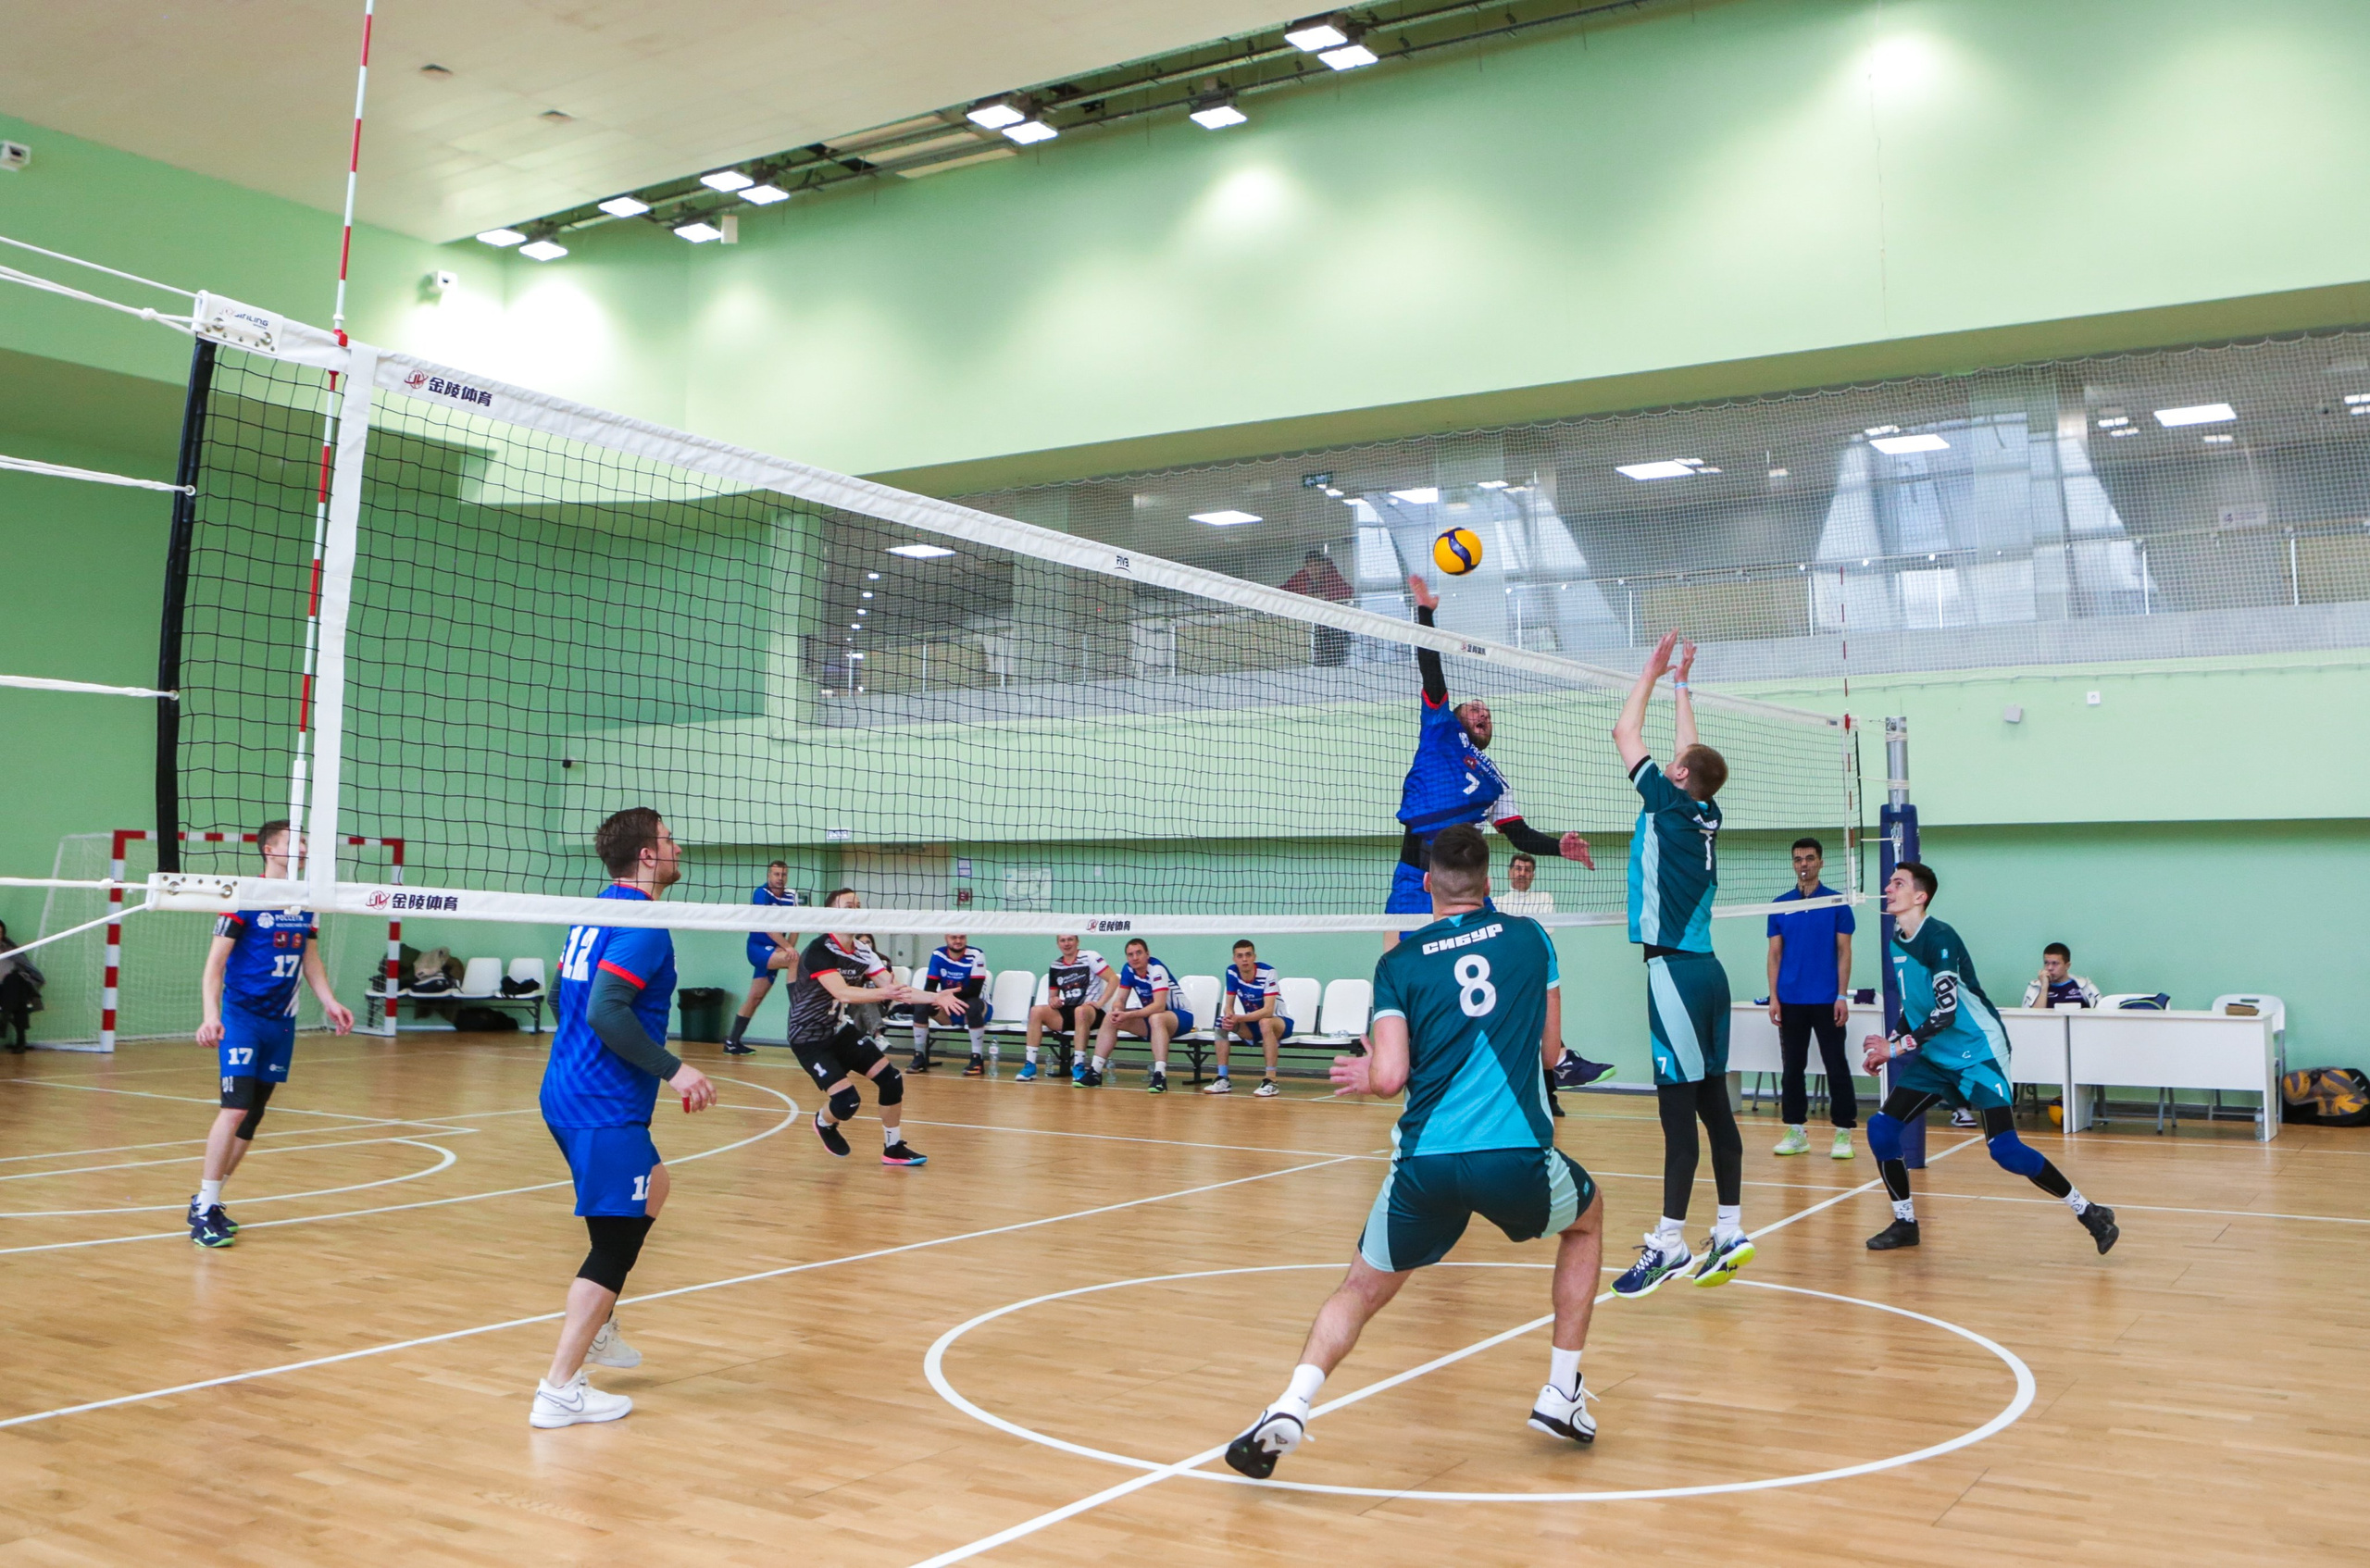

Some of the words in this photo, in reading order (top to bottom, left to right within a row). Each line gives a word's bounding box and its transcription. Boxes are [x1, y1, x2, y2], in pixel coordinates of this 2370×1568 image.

[429, 376, 493, 407] 金陵体育
[1463, 772, 1480, 794] 7
[393, 892, 458, 911] 金陵体育
[1422, 923, 1503, 955] СИБУР
[561, 926, 600, 981] 12
[271, 954, 300, 977] 17
[1453, 953, 1497, 1017] 8
[1898, 968, 1907, 1000] 1
[228, 1047, 254, 1065] 17
[1657, 1057, 1667, 1075] 7
[1995, 1083, 2003, 1098] 1
